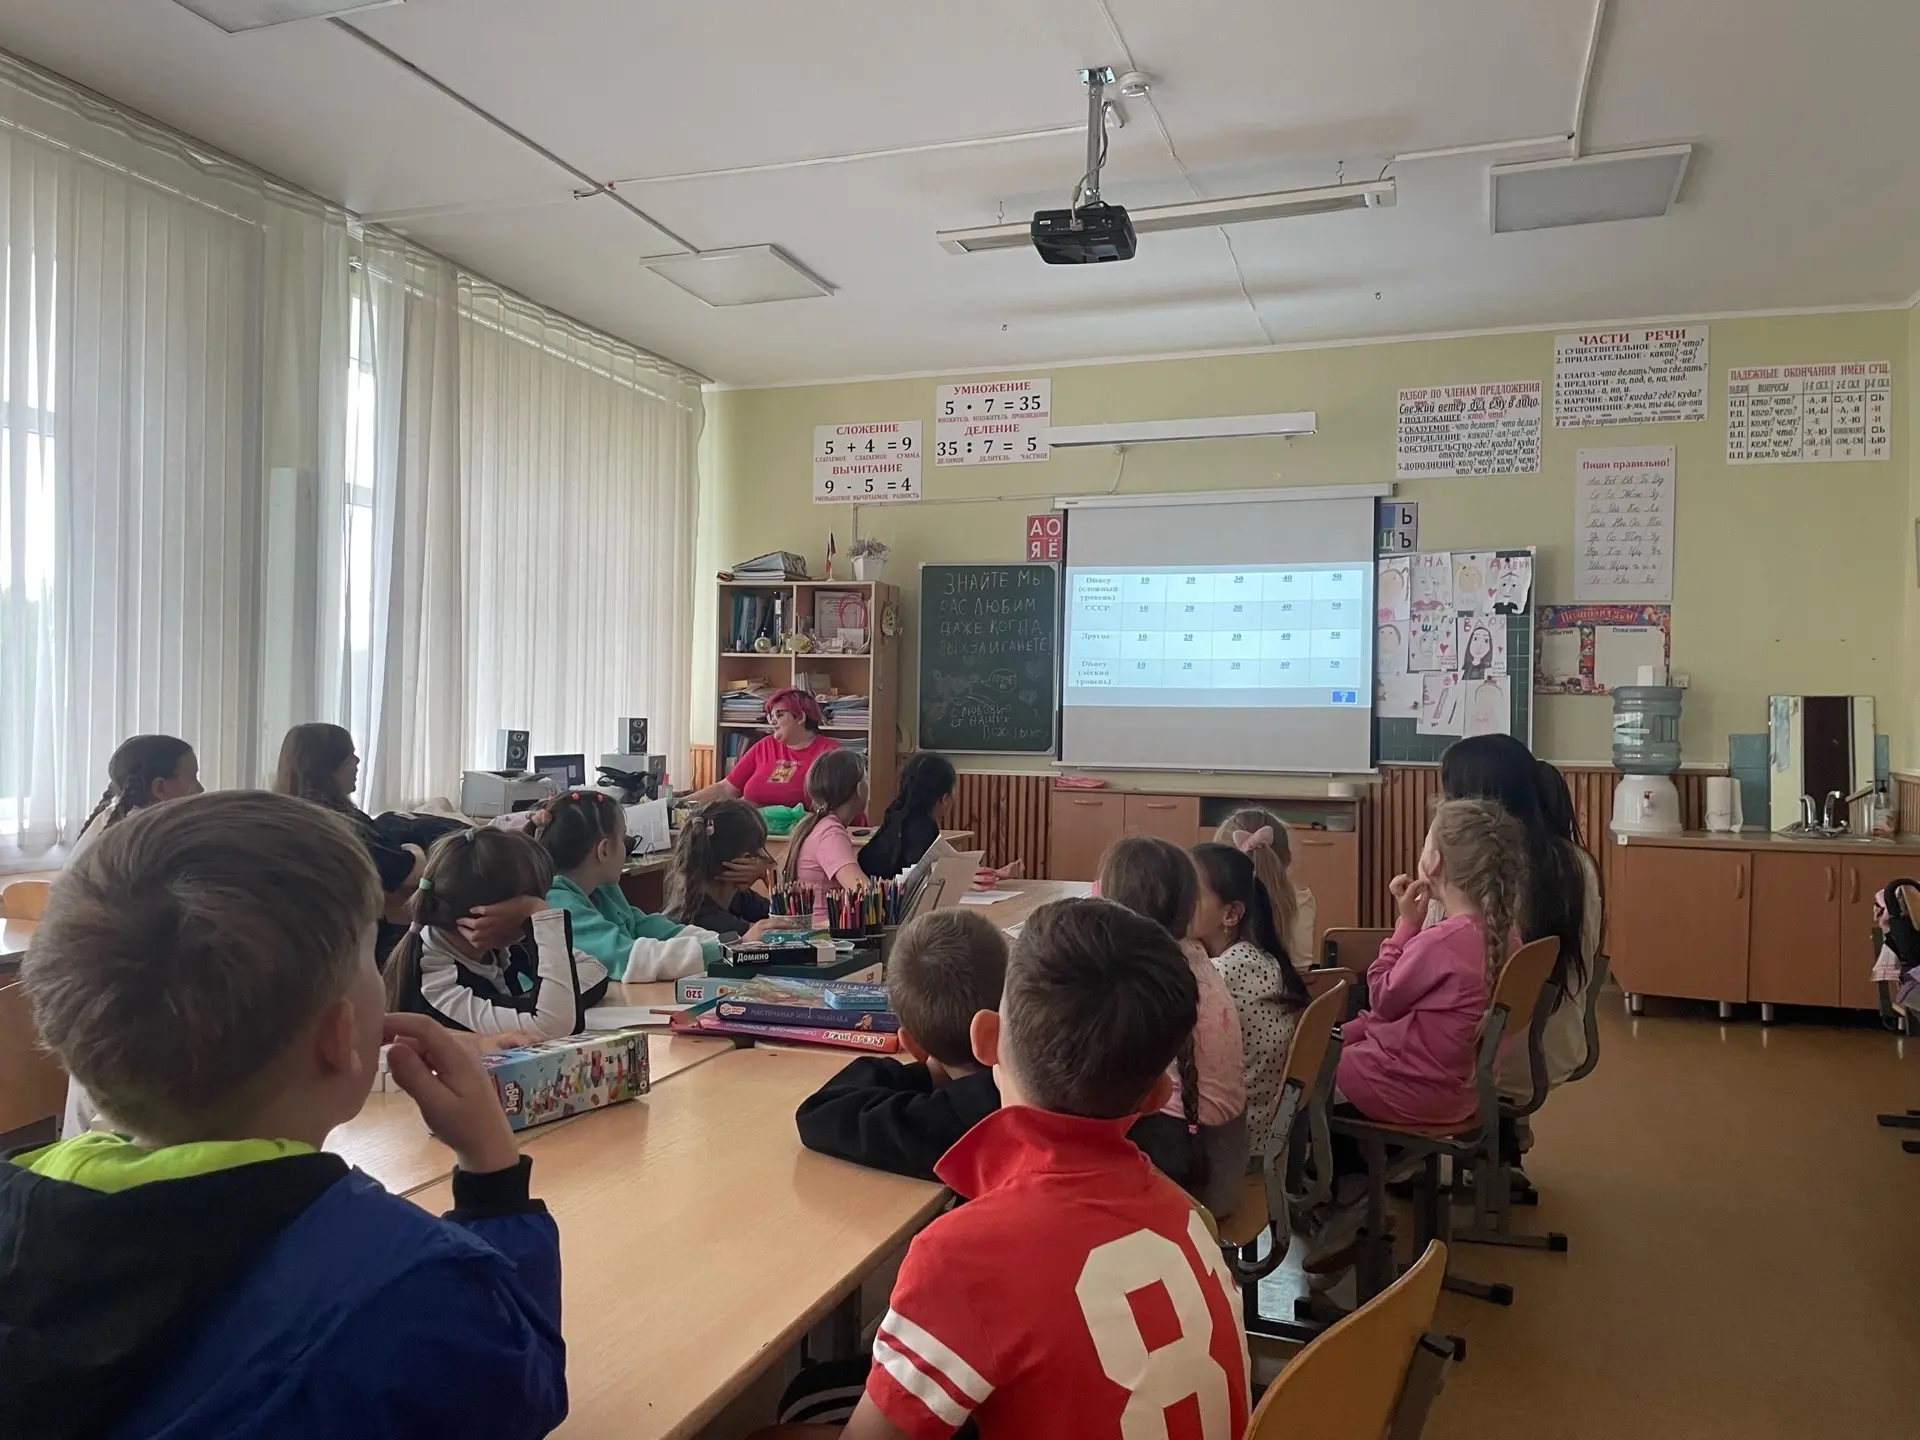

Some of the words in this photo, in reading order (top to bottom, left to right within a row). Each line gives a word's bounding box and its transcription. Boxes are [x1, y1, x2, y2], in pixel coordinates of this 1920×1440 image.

[1579, 333, 1629, 345] ЧАСТИ
[1645, 329, 1685, 341] РЕЧИ
[1565, 345, 1649, 354] СУЩЕСТВИТЕЛЬНОЕ
[1659, 340, 1681, 348] кто?
[1683, 338, 1704, 347] что?
[1565, 353, 1641, 363] ПРИЛАГАТЕЛЬНОЕ
[1650, 348, 1679, 358] какой?
[1669, 363, 1707, 373] сделать?
[1731, 369, 1778, 380] ПАДЕЖНЫЕ
[1784, 365, 1836, 378] ОКОНЧАНИЯ
[954, 382, 1031, 395] УМНОЖЕНИЕ
[1400, 390, 1427, 400] РАЗБОР
[1431, 389, 1441, 398] ПО
[1445, 386, 1476, 397] ЧЛЕНАМ
[1480, 383, 1540, 395] ПРЕДЛОЖЕНИЯ
[1758, 383, 1789, 392] ВОПРОСЫ
[1609, 394, 1628, 402] как?
[1630, 391, 1657, 400] когда?
[1658, 390, 1676, 399] где?
[1678, 389, 1701, 400] куда?
[1751, 396, 1772, 406] кто?
[1774, 396, 1795, 405] что?
[945, 401, 954, 415] 5
[985, 399, 994, 413] 7
[1020, 395, 1041, 411] 35
[1400, 401, 1435, 414] Свежий
[1438, 402, 1466, 413] ветер
[1470, 399, 1486, 412] дул
[1489, 399, 1507, 411] ему
[1515, 398, 1540, 408] лицо.
[1563, 404, 1622, 413] МЕСТОИМЕНИЕ
[1751, 407, 1773, 416] кого?
[1775, 406, 1797, 416] чего?
[1468, 410, 1487, 420] кто?
[1488, 410, 1507, 418] что?
[1405, 424, 1449, 433] СКАЗУЕМОЕ
[1470, 420, 1499, 430] делает?
[1751, 417, 1775, 427] кому?
[1777, 417, 1801, 427] чему?
[837, 424, 899, 435] СЛОЖЕНИЕ
[965, 424, 1020, 436] ДЕЛЕНИЕ
[1405, 434, 1460, 442] ОПРЕДЕЛЕНИЕ
[1468, 430, 1493, 439] какой?
[1751, 428, 1773, 437] кого?
[1777, 427, 1797, 436] что?
[825, 441, 834, 454] 5
[865, 439, 875, 452] 4
[902, 437, 912, 451] 9
[937, 441, 957, 456] 35
[984, 440, 993, 454] 7
[1027, 437, 1036, 451] 5
[1492, 438, 1516, 450] когда?
[1518, 437, 1540, 450] куда?
[1751, 439, 1771, 447] кем?
[1773, 438, 1793, 446] чем?
[833, 464, 902, 474] ВЫЧИТАНИЕ
[1613, 457, 1669, 470] правильно!
[825, 480, 834, 493] 9
[865, 479, 873, 492] 5
[901, 477, 911, 491] 4
[1402, 508, 1412, 524] Ь
[1030, 520, 1043, 536] А
[1047, 519, 1060, 536] О
[1399, 532, 1411, 548] Ъ
[1031, 541, 1041, 558] Я
[1049, 539, 1057, 558] Ё
[1415, 557, 1443, 567] ЯНА
[944, 571, 1008, 595] ЗНАЙТЕ
[1018, 570, 1044, 588] МЫ
[1186, 576, 1196, 584] 20
[1332, 573, 1342, 581] 50
[975, 597, 1036, 616] ЛЮБИМ
[1331, 602, 1341, 610] 50
[941, 622, 982, 636] ДАЖЕ
[990, 619, 1042, 636] КОГДА
[1464, 618, 1505, 632] ВАРЯ
[1232, 633, 1242, 641] 30
[1331, 632, 1340, 640] 50
[1280, 661, 1290, 669] 40
[1330, 660, 1340, 668] 50
[737, 953, 769, 963] Домино
[823, 1031, 850, 1040] ЯРКИЕ
[852, 1036, 884, 1047] ДРУЗЬЯ
[504, 1083, 518, 1113] Jenga
